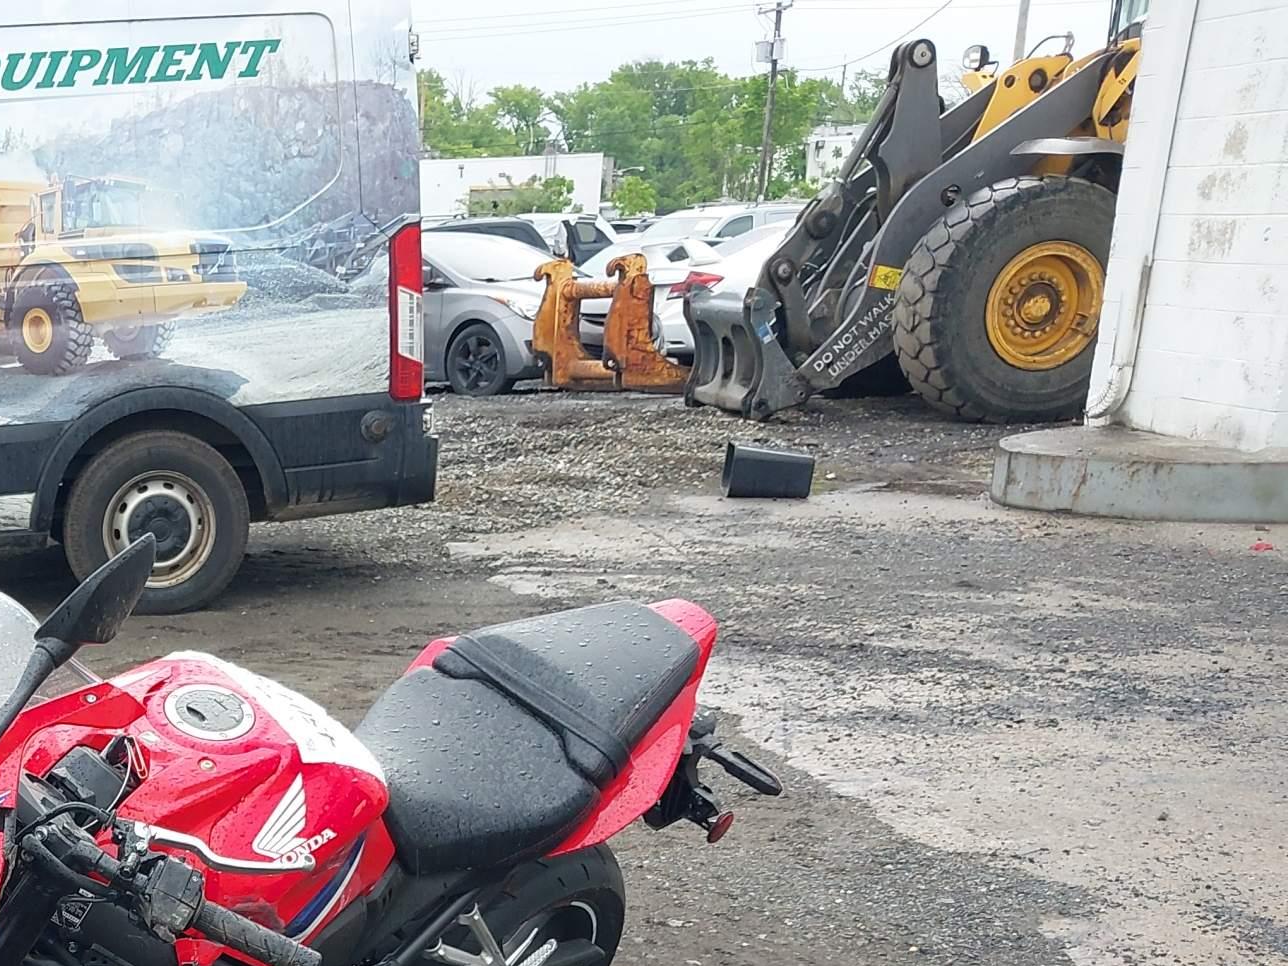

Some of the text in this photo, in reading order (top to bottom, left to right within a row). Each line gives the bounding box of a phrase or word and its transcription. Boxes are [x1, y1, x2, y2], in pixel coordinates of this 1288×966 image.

[813, 293, 895, 373] DO NOT WALK
[827, 337, 871, 378] UNDER
